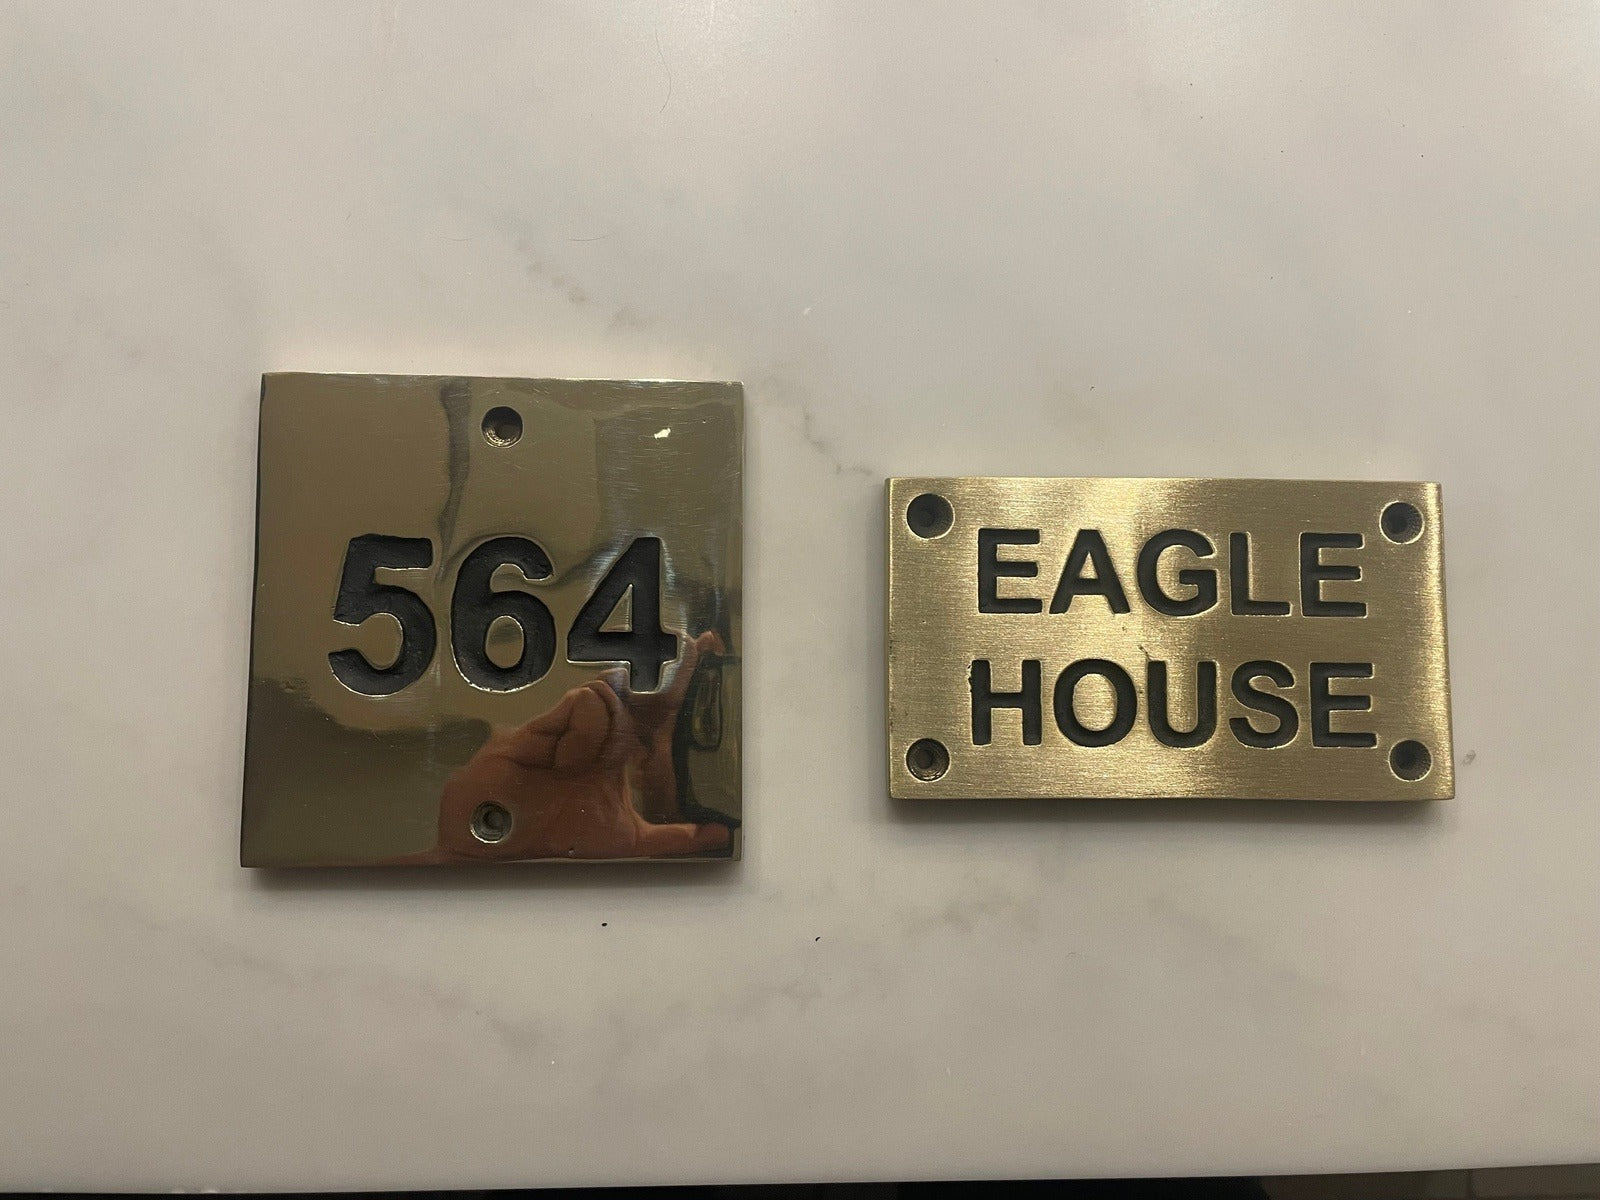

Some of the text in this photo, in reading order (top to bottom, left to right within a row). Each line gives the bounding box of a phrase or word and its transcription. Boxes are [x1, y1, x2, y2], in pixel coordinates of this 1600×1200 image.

[328, 532, 679, 696] 564
[977, 527, 1367, 617] EAGLE
[967, 658, 1377, 749] HOUSE
